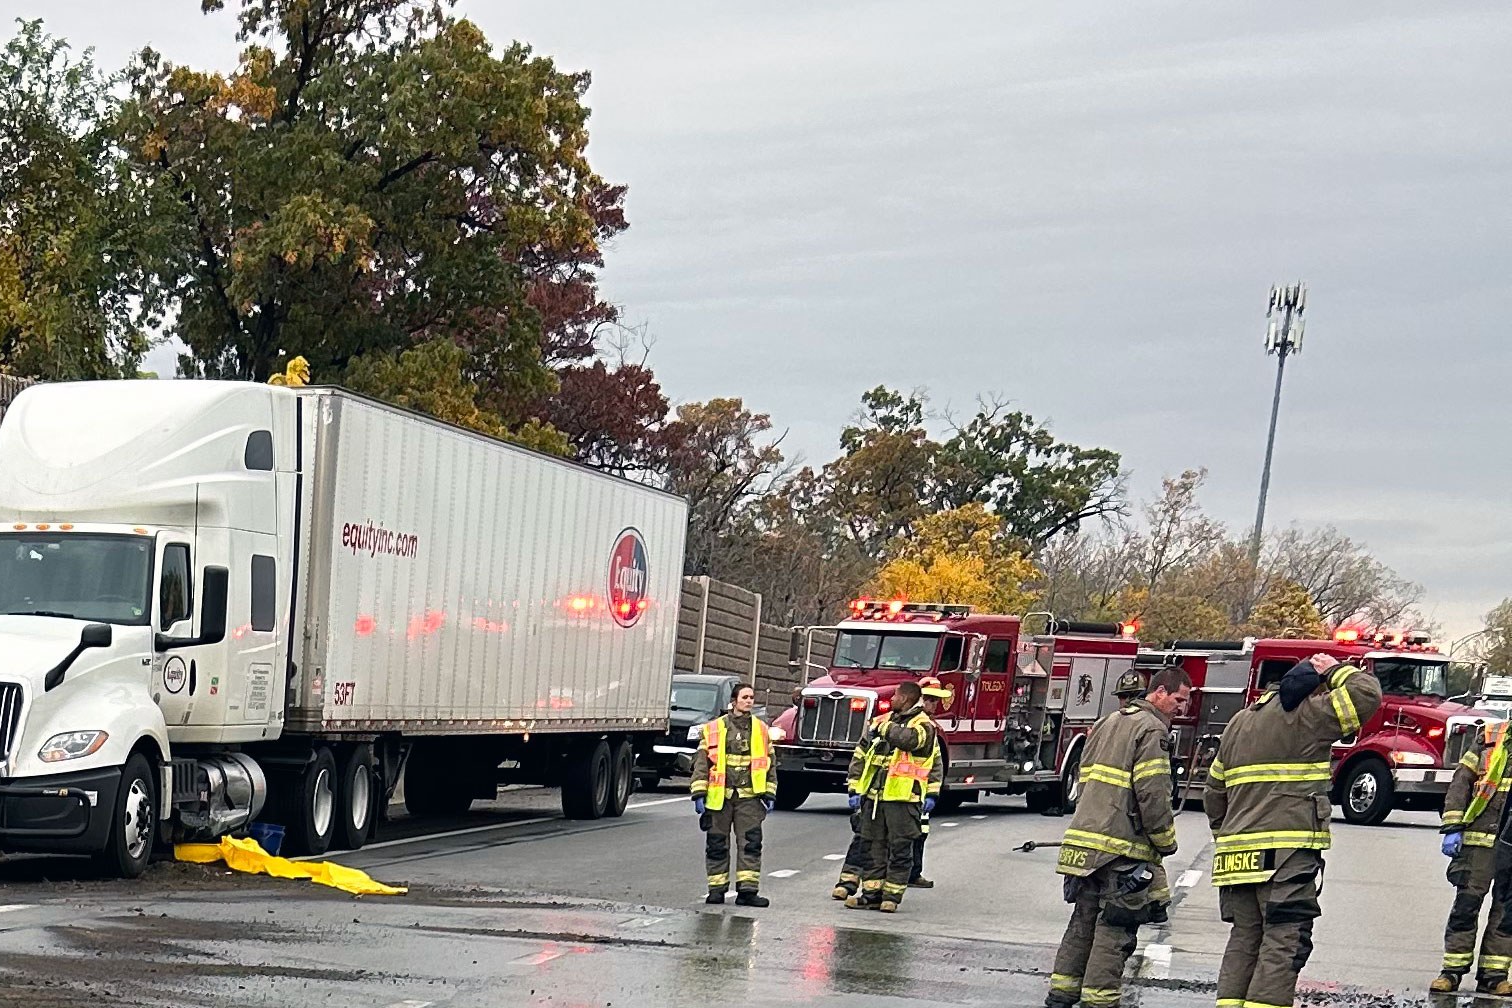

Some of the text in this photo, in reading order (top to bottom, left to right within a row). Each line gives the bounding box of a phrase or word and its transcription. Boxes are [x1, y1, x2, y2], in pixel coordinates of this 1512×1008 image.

[342, 518, 418, 559] equityinc.com
[334, 682, 356, 706] 53FT
[982, 681, 1006, 692] TOLEDO
